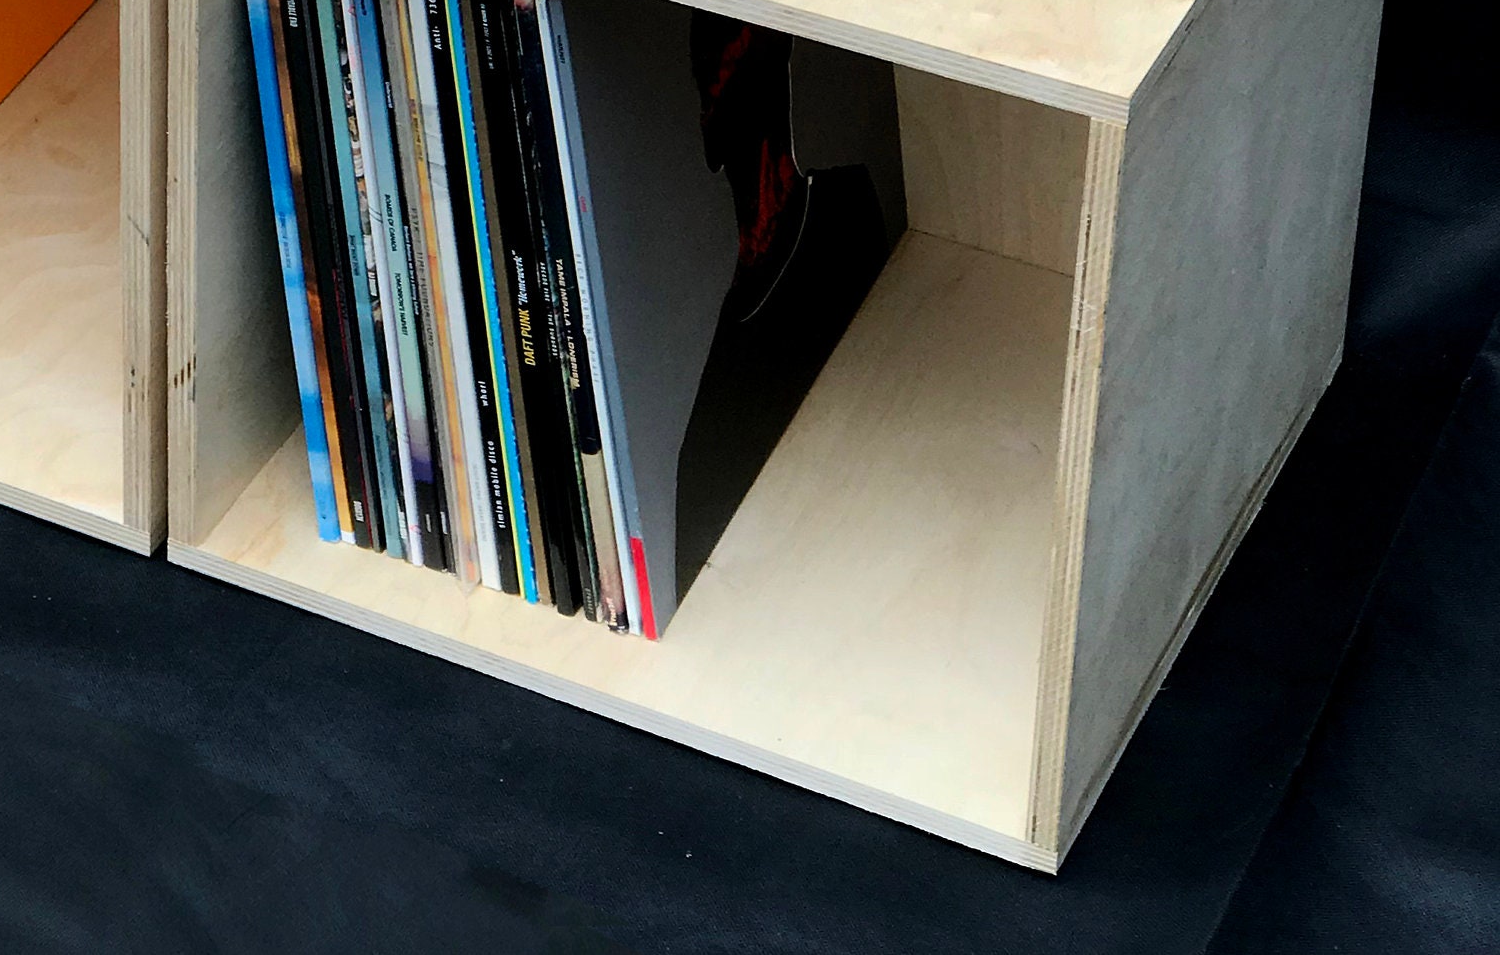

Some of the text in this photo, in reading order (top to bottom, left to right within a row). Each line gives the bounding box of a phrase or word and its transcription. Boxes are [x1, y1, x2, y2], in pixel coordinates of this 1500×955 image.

[384, 194, 398, 252] BOARDS OF CANADA
[518, 308, 533, 338] PUNK
[521, 338, 537, 366] DAFT
[554, 258, 582, 388] TAME IMPALA LONERISM
[477, 380, 507, 529] simian mobile disco whorl
